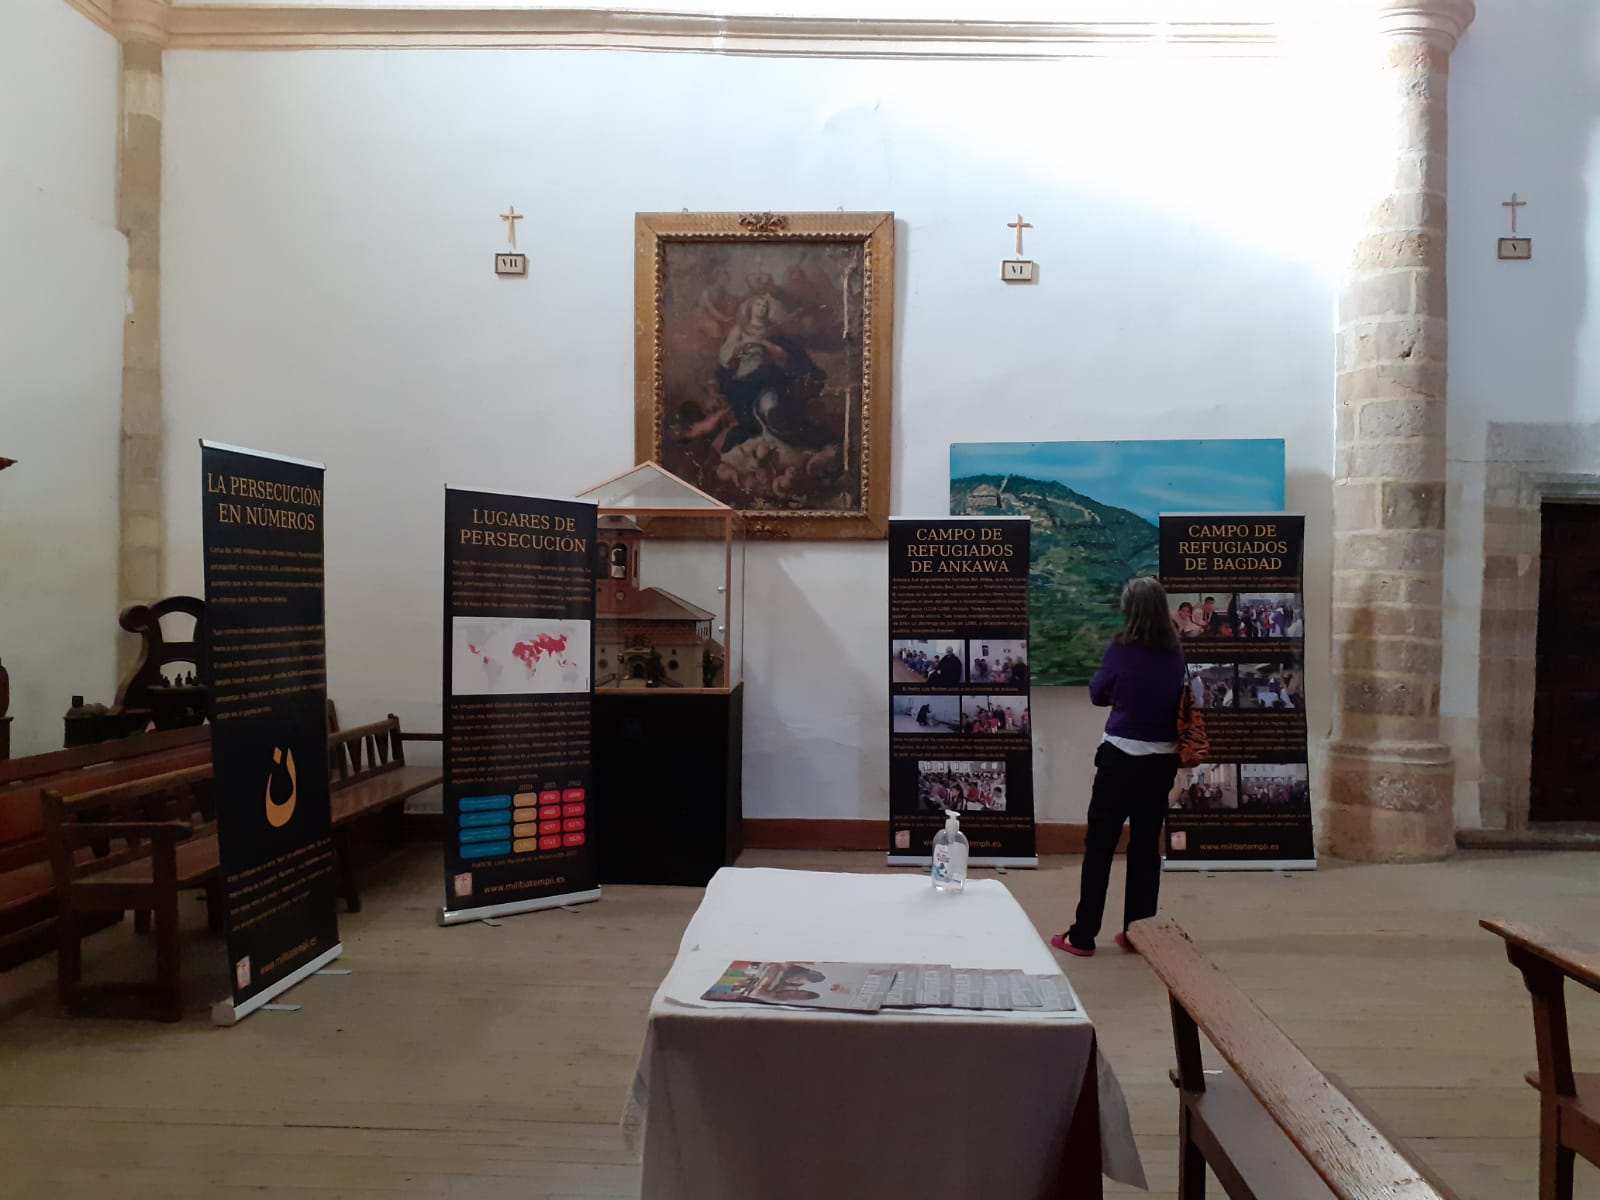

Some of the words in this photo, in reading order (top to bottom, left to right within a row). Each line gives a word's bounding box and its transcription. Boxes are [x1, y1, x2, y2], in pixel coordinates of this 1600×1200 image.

[207, 472, 226, 494] LA
[229, 476, 321, 506] PERSECUCIÓN
[218, 503, 241, 524] EN
[246, 503, 315, 531] NÚMEROS
[472, 508, 550, 530] LUGARES
[554, 516, 576, 532] DE
[916, 528, 976, 541] CAMPO
[981, 528, 1003, 541] DE
[1188, 524, 1249, 538] CAMPO
[1255, 524, 1277, 537] DE
[459, 528, 587, 553] PERSECUCIÓN
[1178, 541, 1288, 554] REFUGIADOS
[907, 544, 1014, 557] REFUGIADOS
[911, 560, 933, 573] DE
[937, 560, 1009, 573] ANKAWA
[1184, 557, 1207, 571] DE
[1213, 557, 1282, 571] BAGDAD
